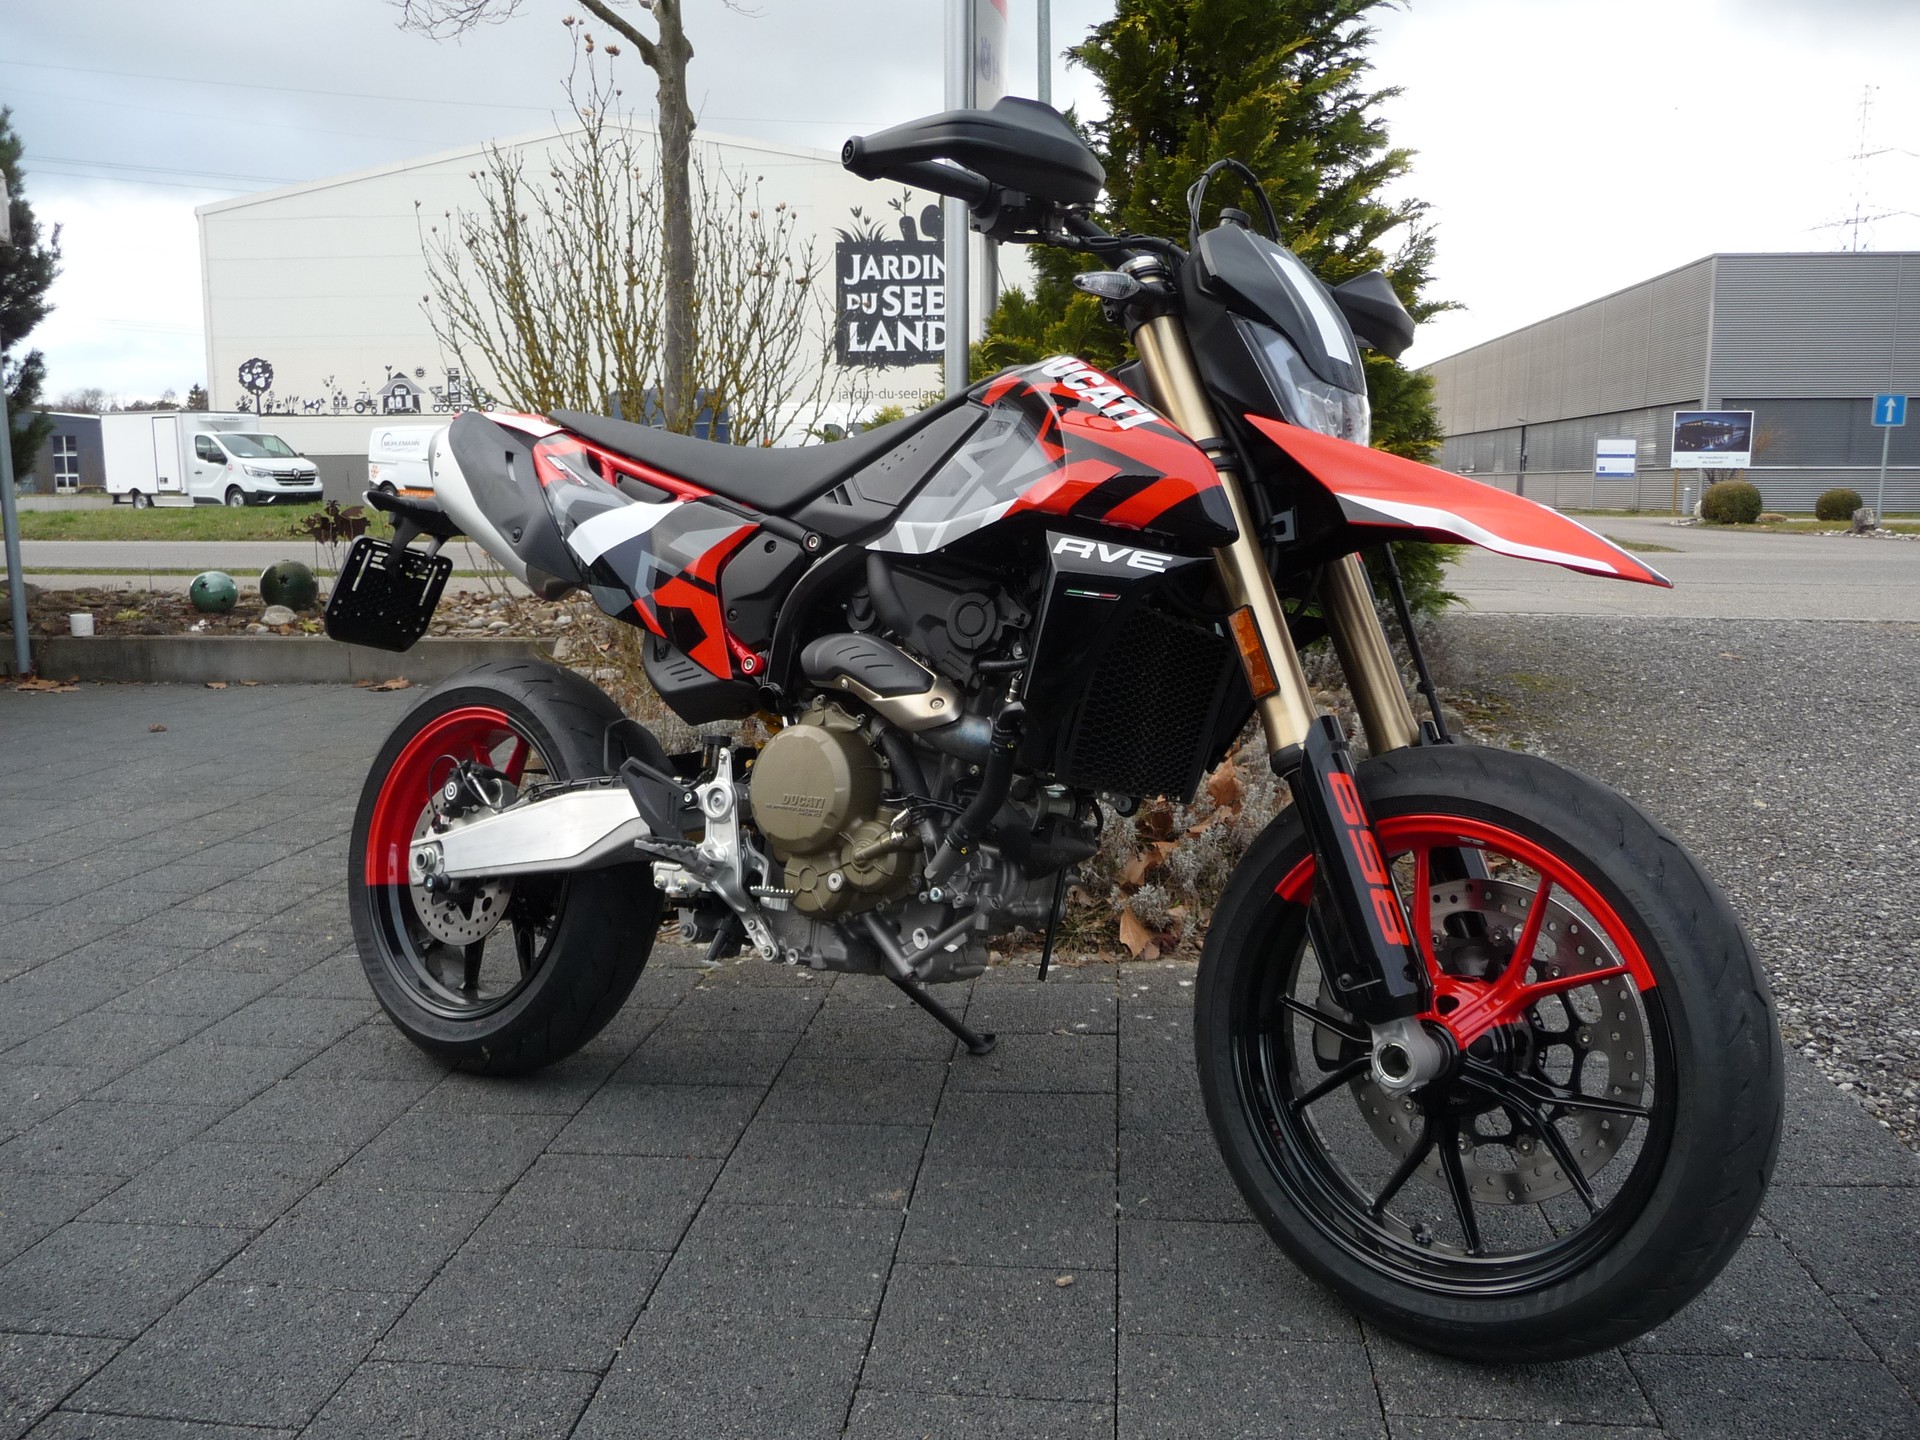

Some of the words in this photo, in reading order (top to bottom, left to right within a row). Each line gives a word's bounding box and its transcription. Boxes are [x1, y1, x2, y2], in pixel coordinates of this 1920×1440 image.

[844, 254, 945, 285] JARDIN
[846, 293, 878, 315] DU
[882, 285, 945, 317] SEE
[848, 320, 946, 352] LAND
[1026, 356, 1160, 430] UCATI
[1052, 537, 1174, 573] RVE
[783, 794, 826, 809] DUCATI
